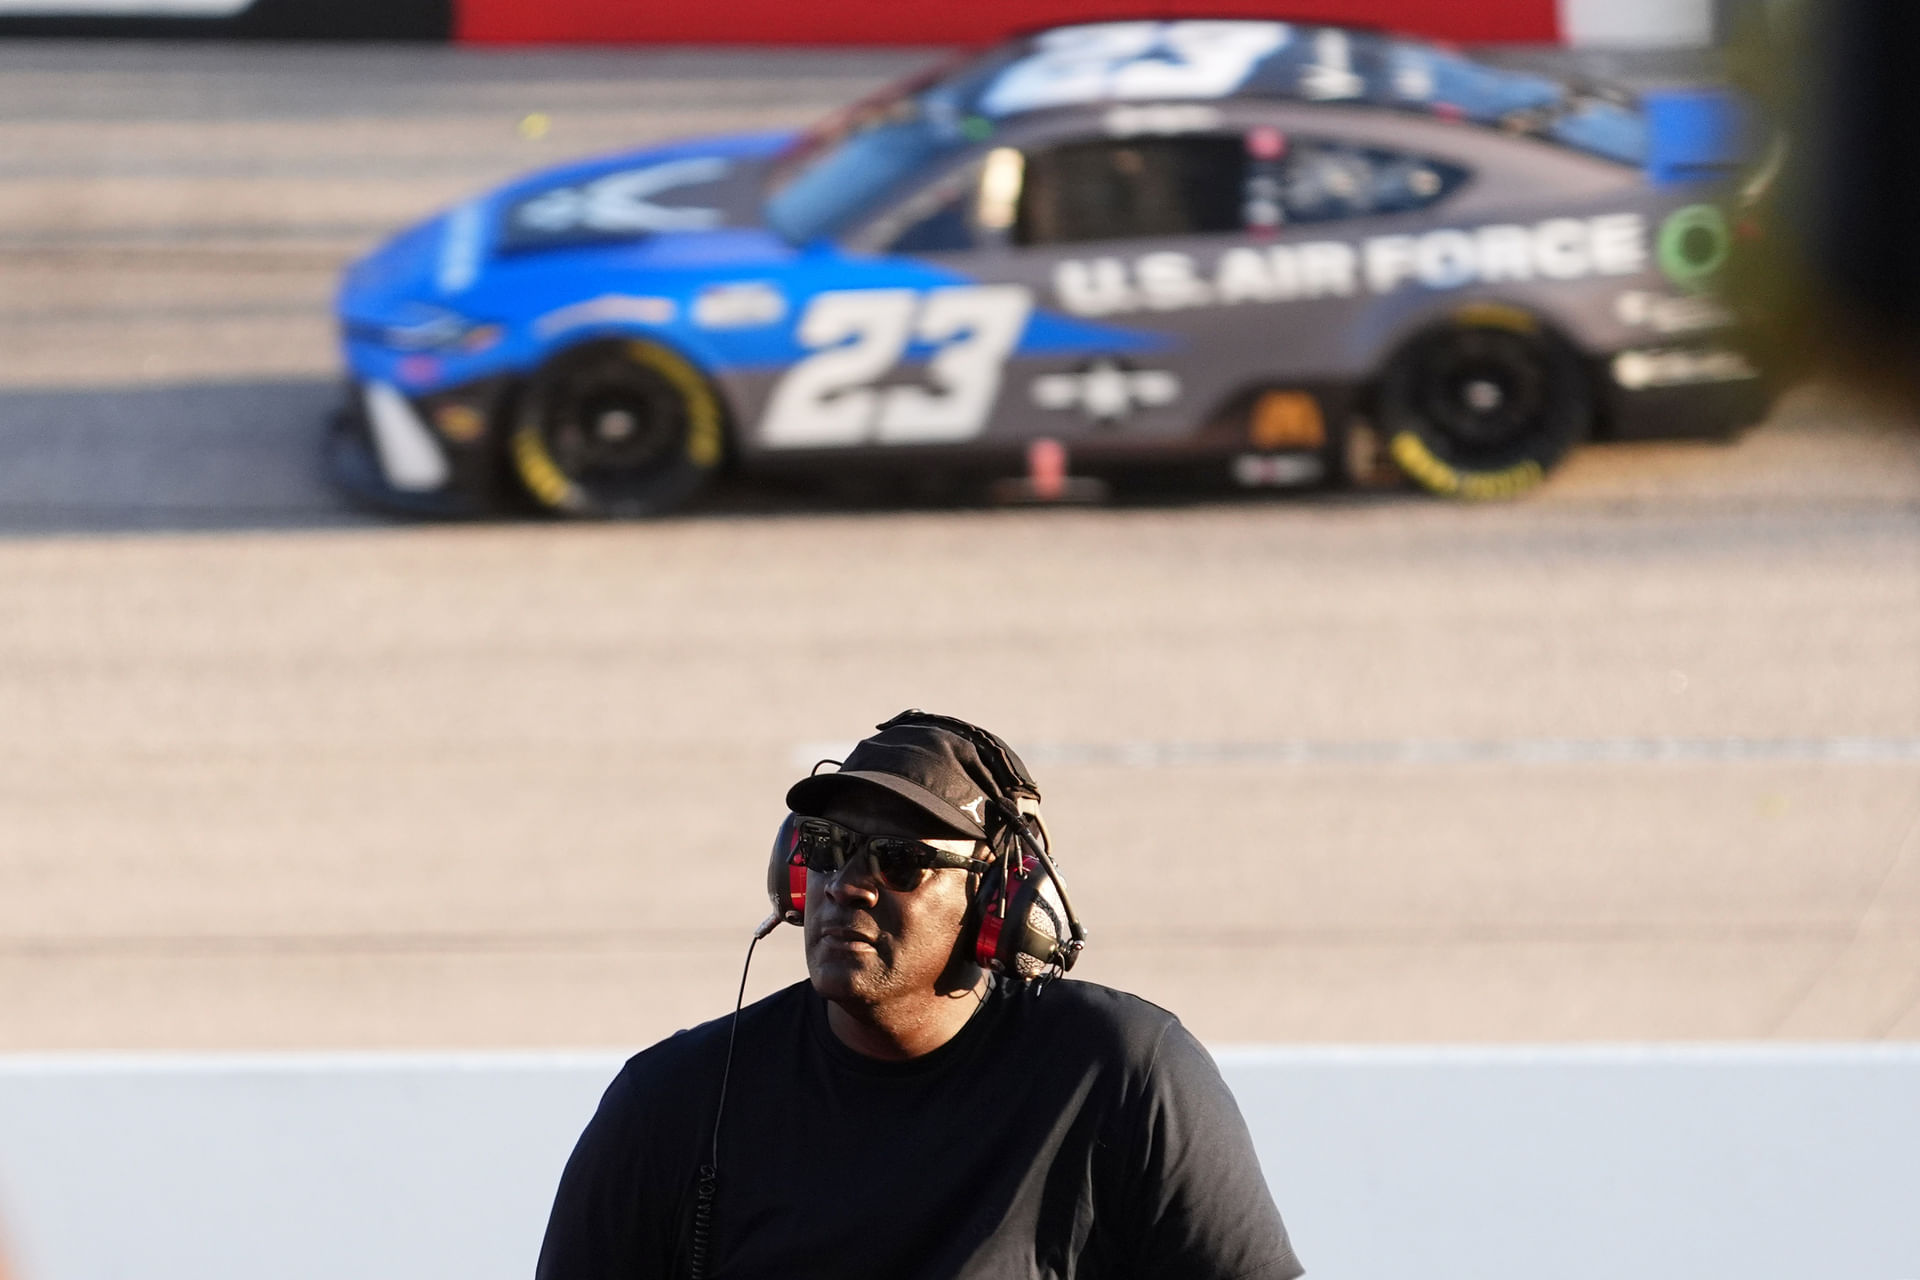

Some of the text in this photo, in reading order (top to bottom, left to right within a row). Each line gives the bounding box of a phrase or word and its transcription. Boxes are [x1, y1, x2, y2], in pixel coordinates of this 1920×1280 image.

[1217, 241, 1353, 304] AIR
[1364, 213, 1644, 292] FORCE
[762, 284, 1033, 446] 23
